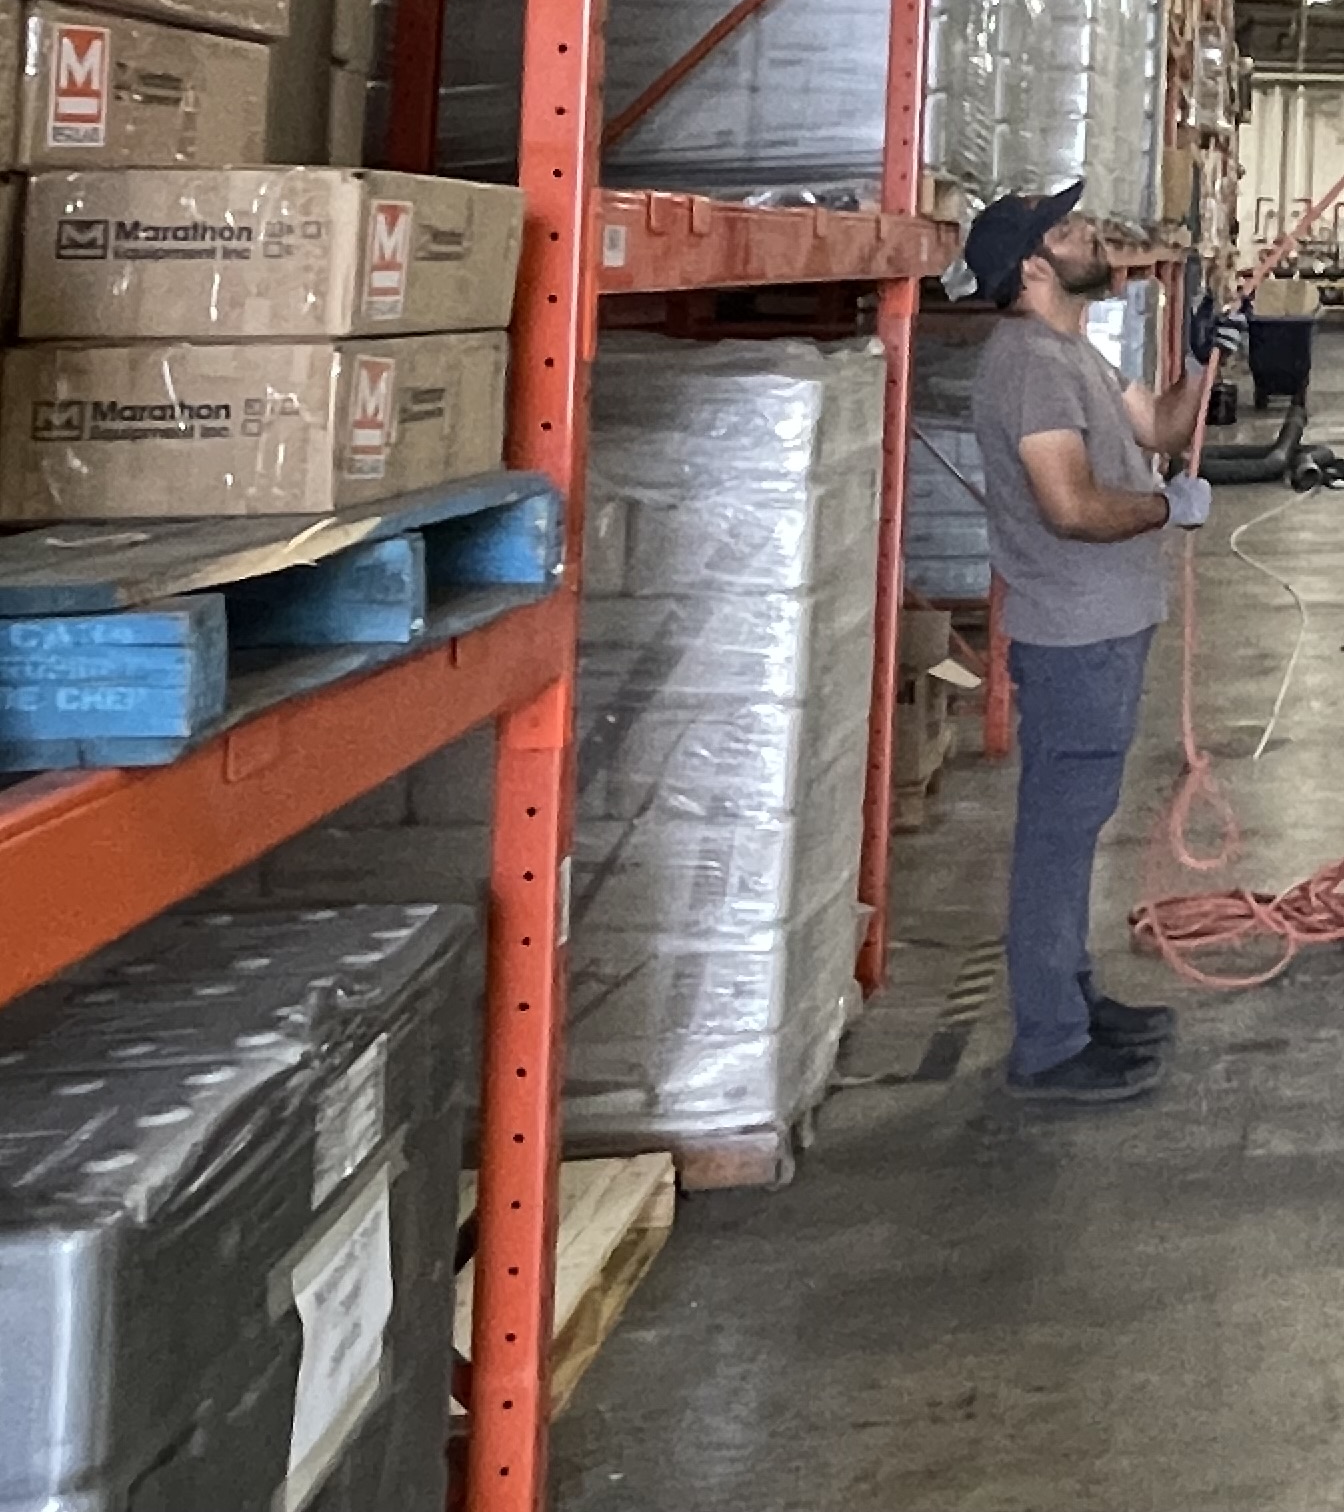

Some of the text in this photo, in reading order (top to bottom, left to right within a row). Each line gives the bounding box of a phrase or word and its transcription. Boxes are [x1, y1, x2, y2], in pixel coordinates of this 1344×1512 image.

[59, 36, 103, 90] M
[114, 220, 253, 243] Marathon
[90, 399, 232, 423] Marathon
